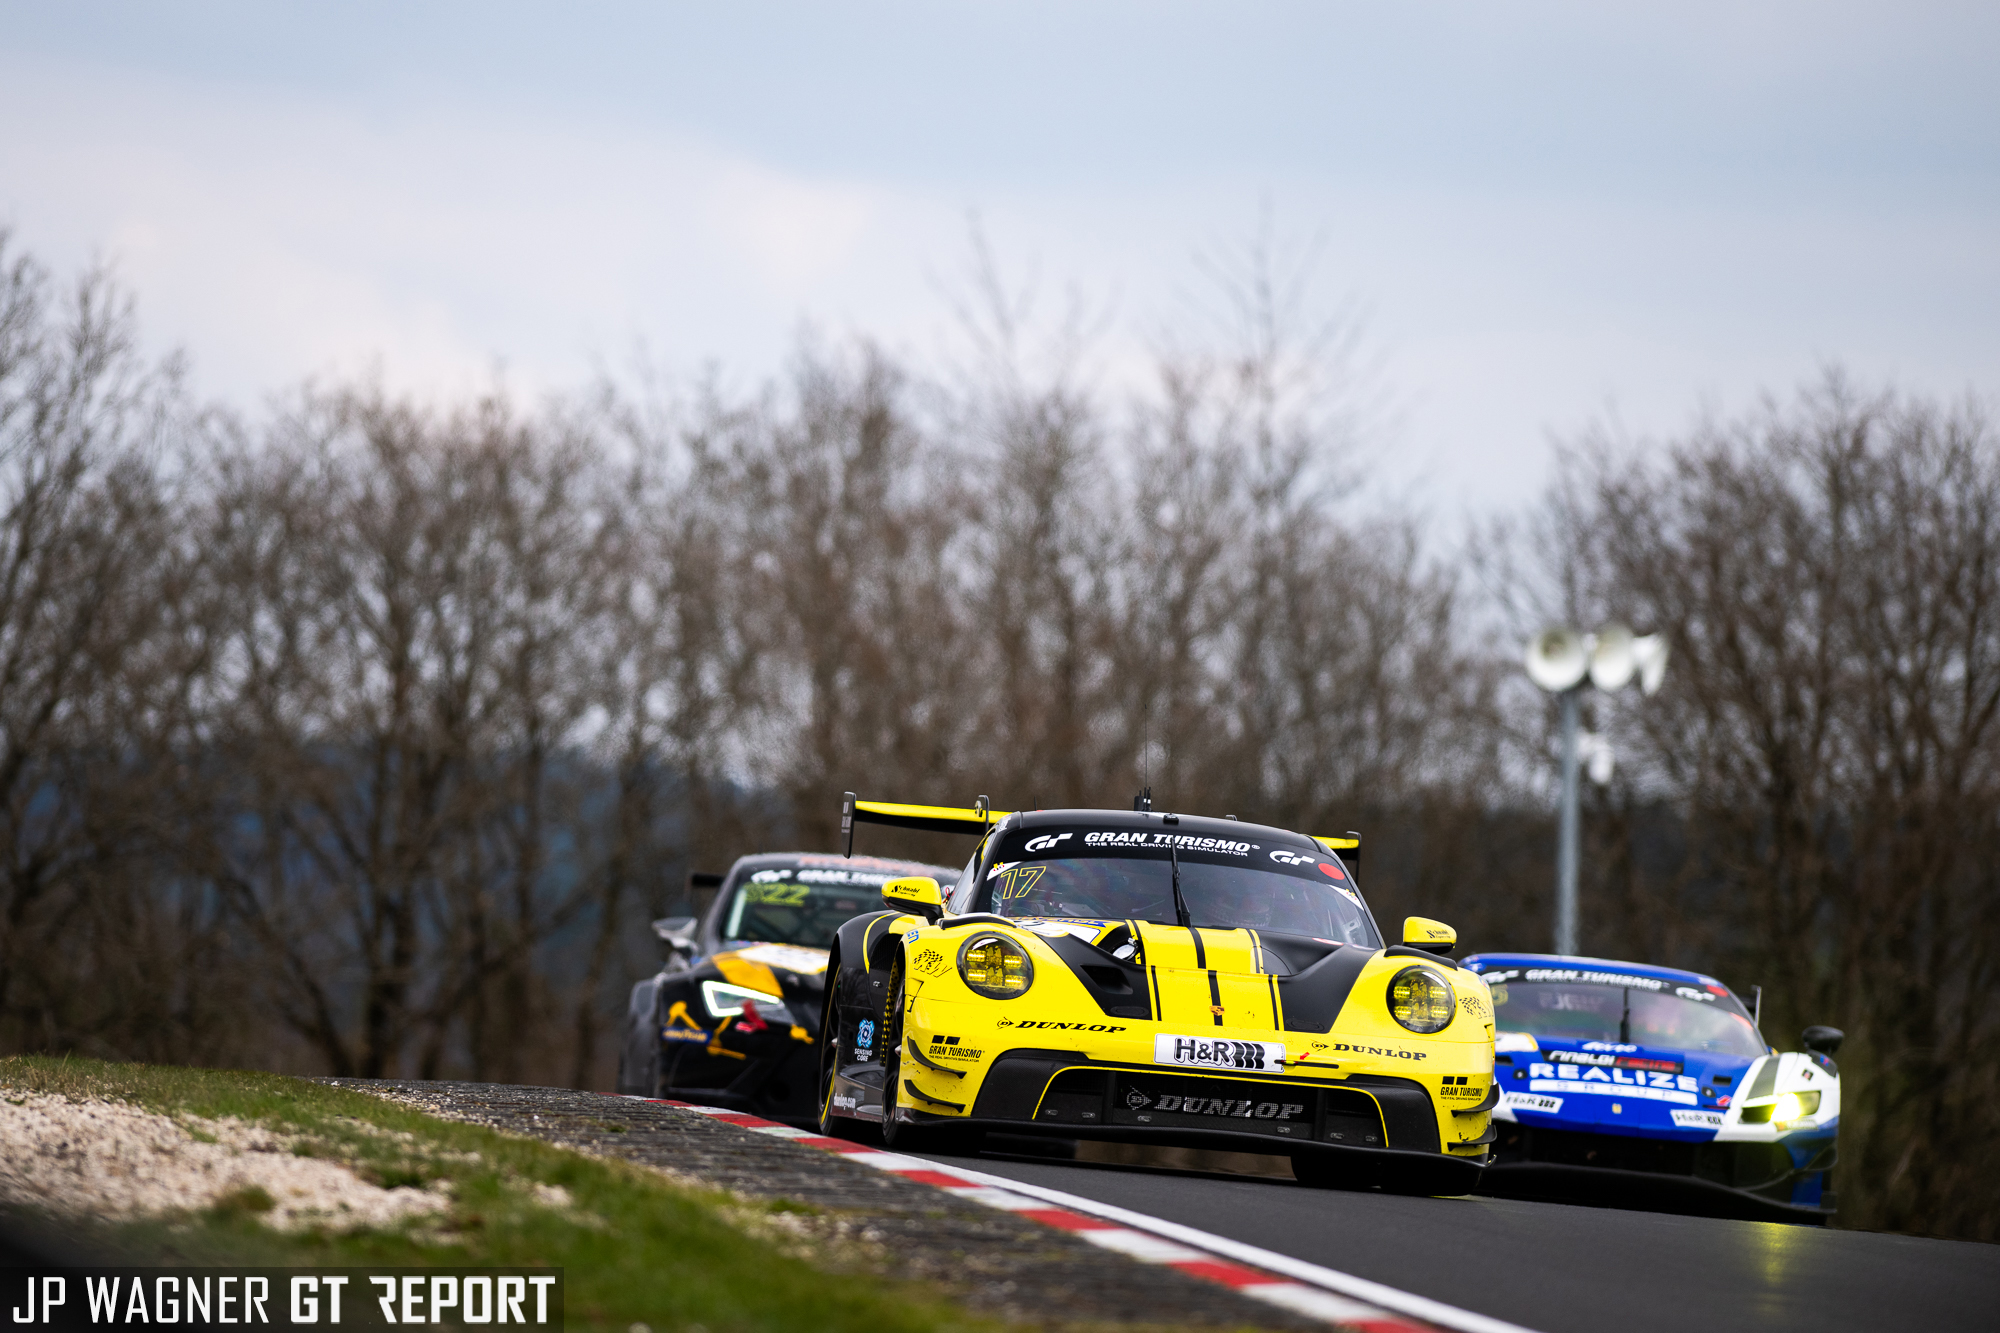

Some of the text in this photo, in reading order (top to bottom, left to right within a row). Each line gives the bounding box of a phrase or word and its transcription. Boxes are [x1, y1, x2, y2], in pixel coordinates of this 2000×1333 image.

[1084, 832, 1147, 843] GRAN
[1187, 845, 1248, 857] SIMULATOR
[1000, 866, 1047, 900] 17
[1525, 969, 1578, 981] GRAN
[1015, 1020, 1127, 1033] DUNLOP
[929, 1045, 947, 1055] GRAN
[1175, 1038, 1232, 1064] H&R
[1333, 1043, 1427, 1061] DUNLOP
[1529, 1062, 1699, 1093] REALIZE
[1440, 1087, 1458, 1096] GRAN
[1557, 1079, 1672, 1099] GROUP
[1154, 1094, 1304, 1119] DUNLOP
